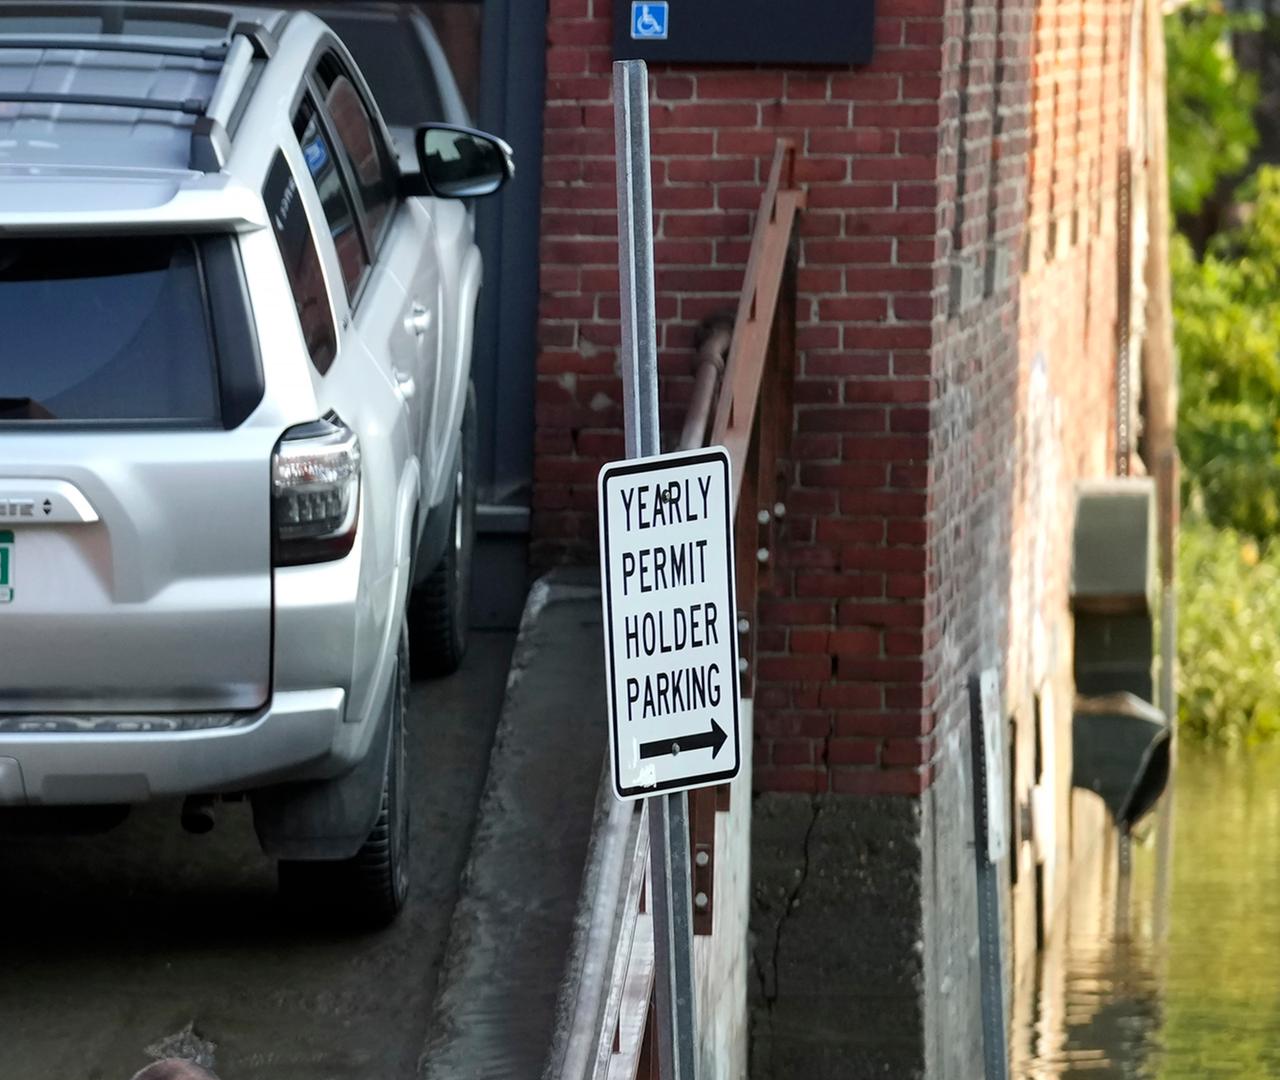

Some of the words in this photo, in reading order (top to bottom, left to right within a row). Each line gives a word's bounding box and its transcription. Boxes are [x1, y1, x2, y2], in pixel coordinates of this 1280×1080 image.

[620, 475, 713, 532] YEARLY
[622, 539, 708, 596] PERMIT
[625, 601, 719, 660] HOLDER
[627, 662, 722, 722] PARKING
